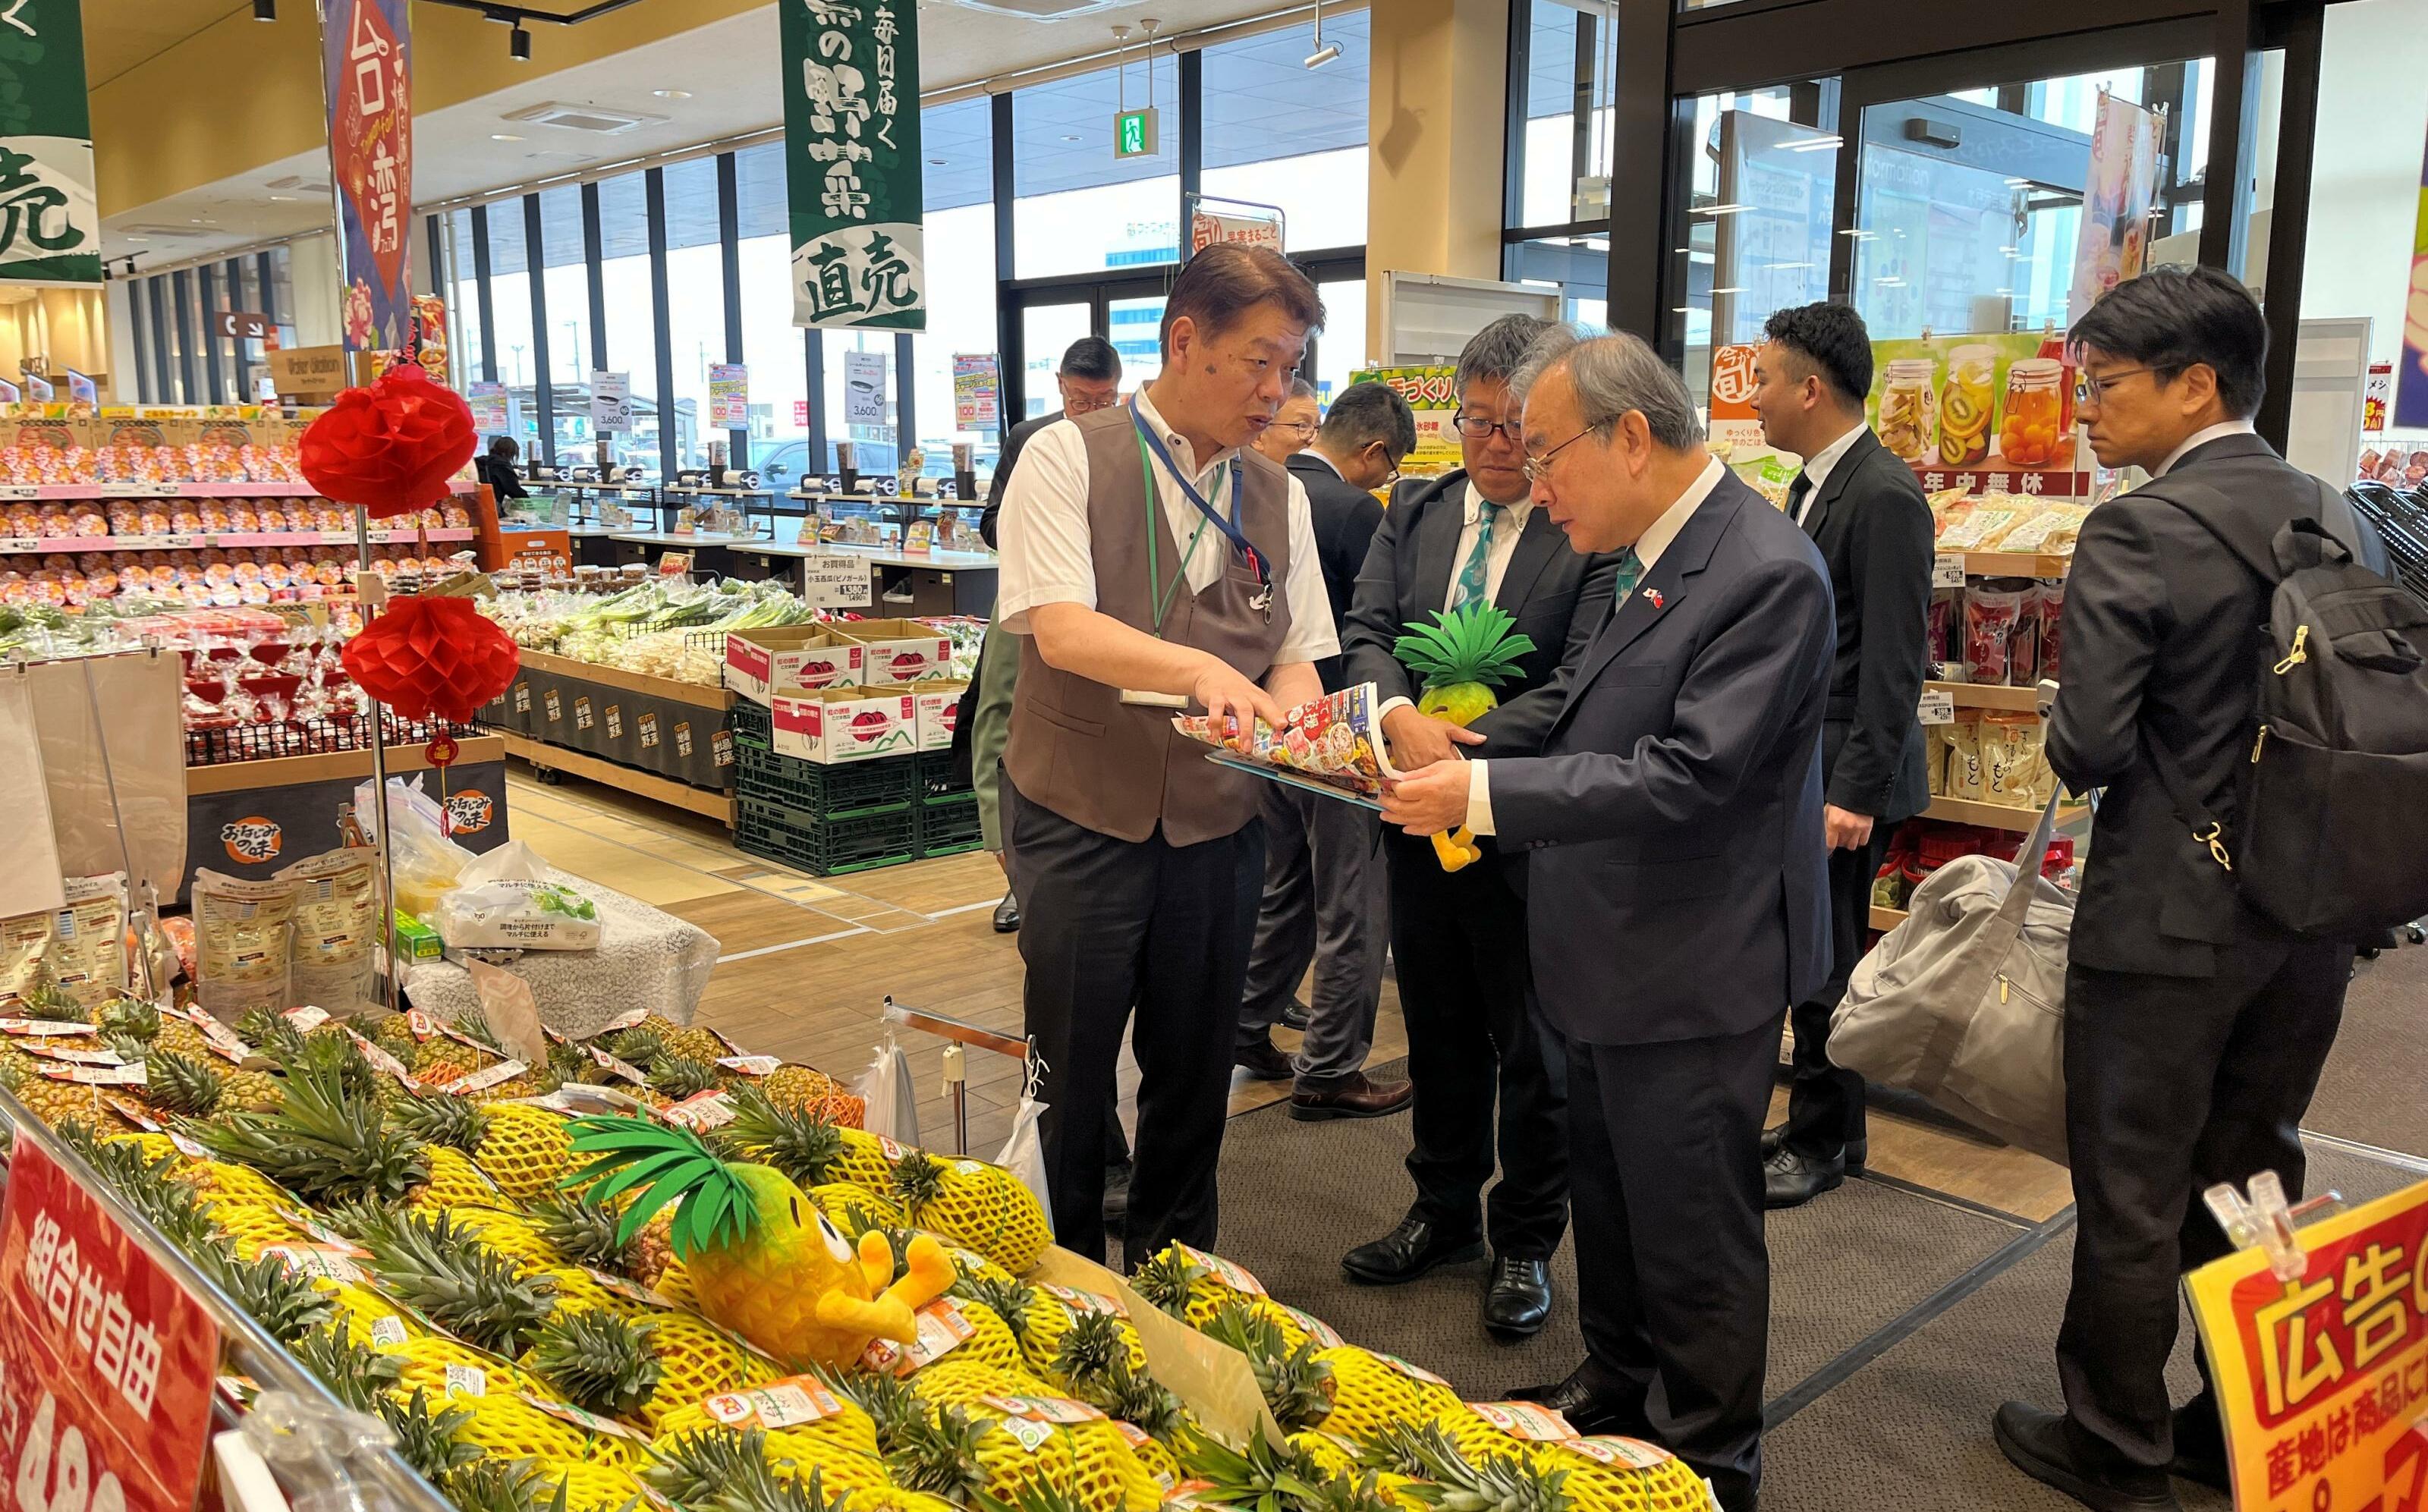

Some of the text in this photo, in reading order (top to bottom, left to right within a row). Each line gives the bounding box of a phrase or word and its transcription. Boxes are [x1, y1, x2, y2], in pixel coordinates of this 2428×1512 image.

[871, 5, 901, 150] 毎日届く
[804, 231, 918, 323] 直売
[1721, 347, 1750, 366] 今が
[1923, 472, 2043, 495] 年中無休
[822, 560, 855, 569] お買得品
[1992, 762, 2004, 793] もと
[446, 797, 491, 813] おなじみ
[455, 811, 488, 828] の味
[223, 825, 278, 841] おなじみ
[237, 839, 277, 858] の味
[26, 1208, 162, 1422] 組合せ自由
